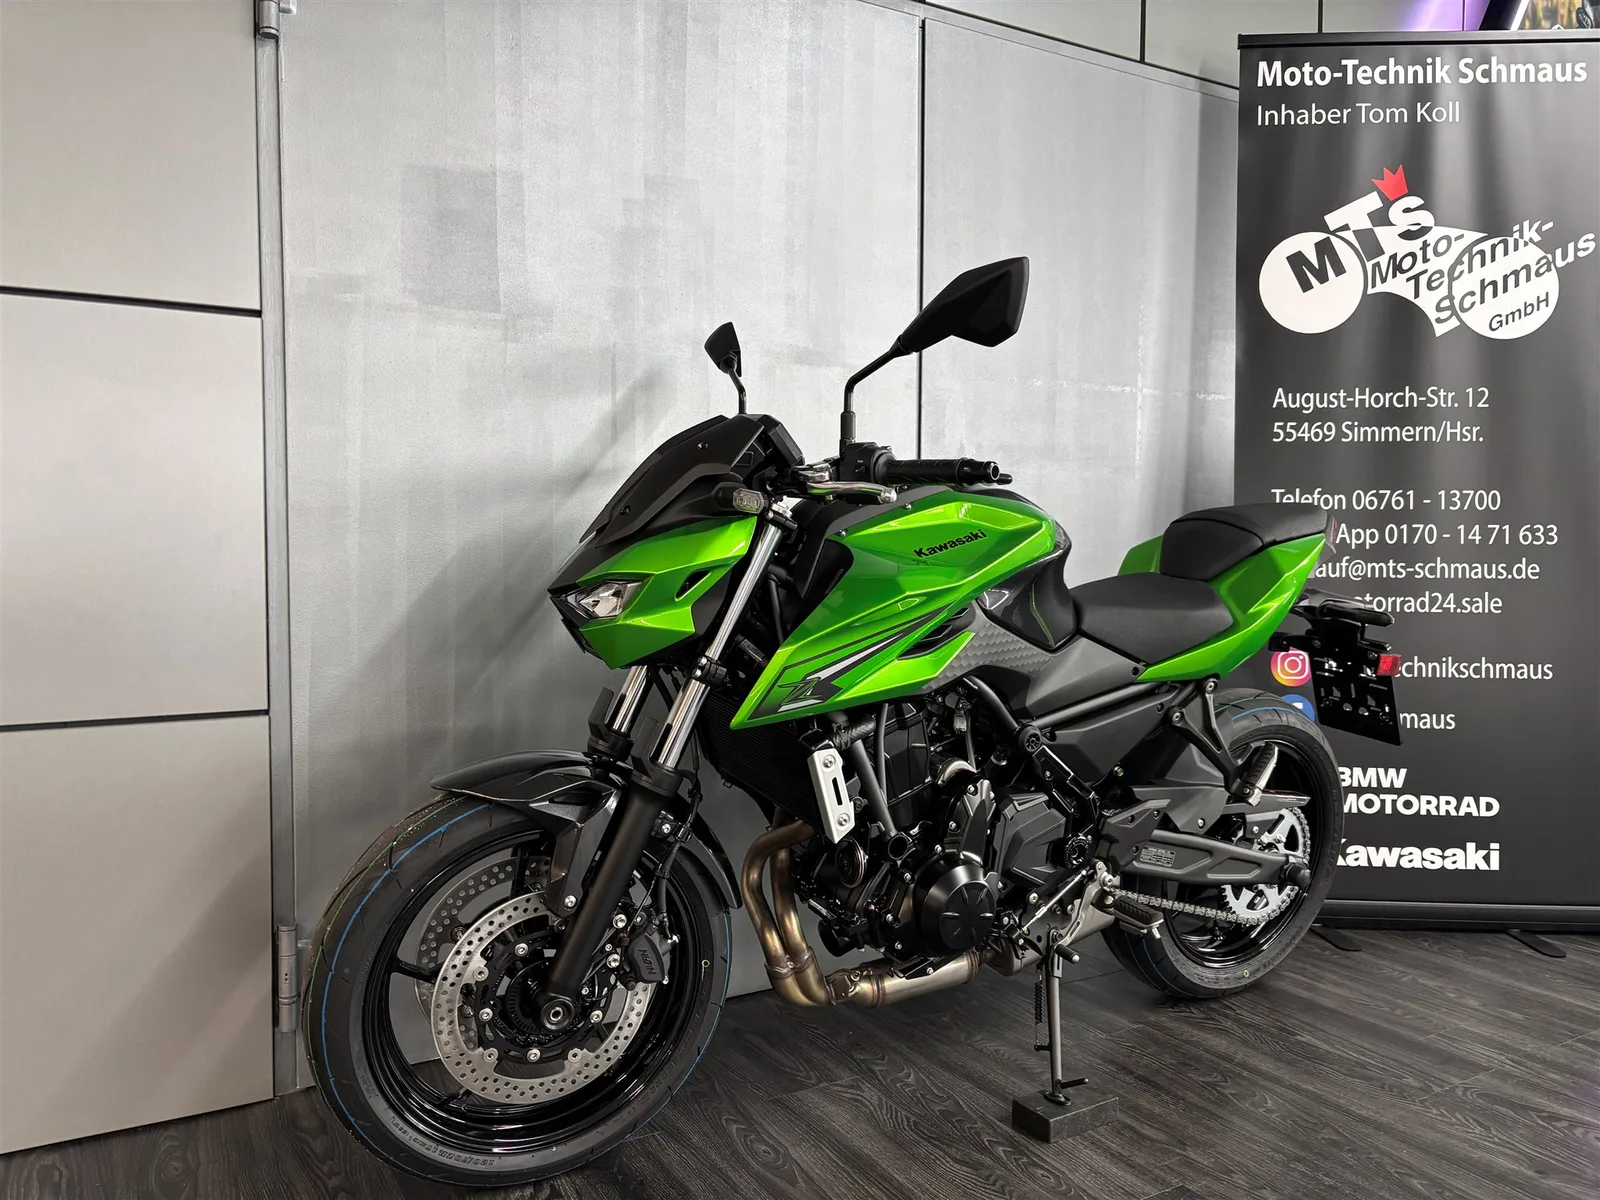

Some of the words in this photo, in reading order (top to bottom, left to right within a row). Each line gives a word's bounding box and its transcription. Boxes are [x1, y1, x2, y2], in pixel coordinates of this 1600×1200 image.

[1256, 57, 1452, 87] Moto-Technik
[1458, 56, 1588, 84] Schmaus
[1257, 103, 1352, 126] Inhaber
[1356, 103, 1408, 124] Tom
[1416, 101, 1460, 123] Koll
[1371, 233, 1465, 289] Moto-
[1405, 219, 1554, 299] Technik-
[1434, 232, 1596, 324] Schmaus
[1488, 291, 1550, 332] GmbH
[1272, 386, 1459, 414] August-Horch-Str.
[1465, 387, 1490, 408] 12
[1272, 422, 1336, 442] 55469
[1341, 421, 1484, 443] Simmern/Hsr.
[1352, 490, 1415, 510] 06761
[1438, 490, 1501, 511] 13700
[913, 529, 988, 558] Kawasaki
[1384, 524, 1438, 544] 0170
[1457, 525, 1482, 545] 14
[1487, 525, 1510, 545] 71
[1518, 526, 1558, 545] 633
[1310, 556, 1540, 581] auf@mts-schmaus.de
